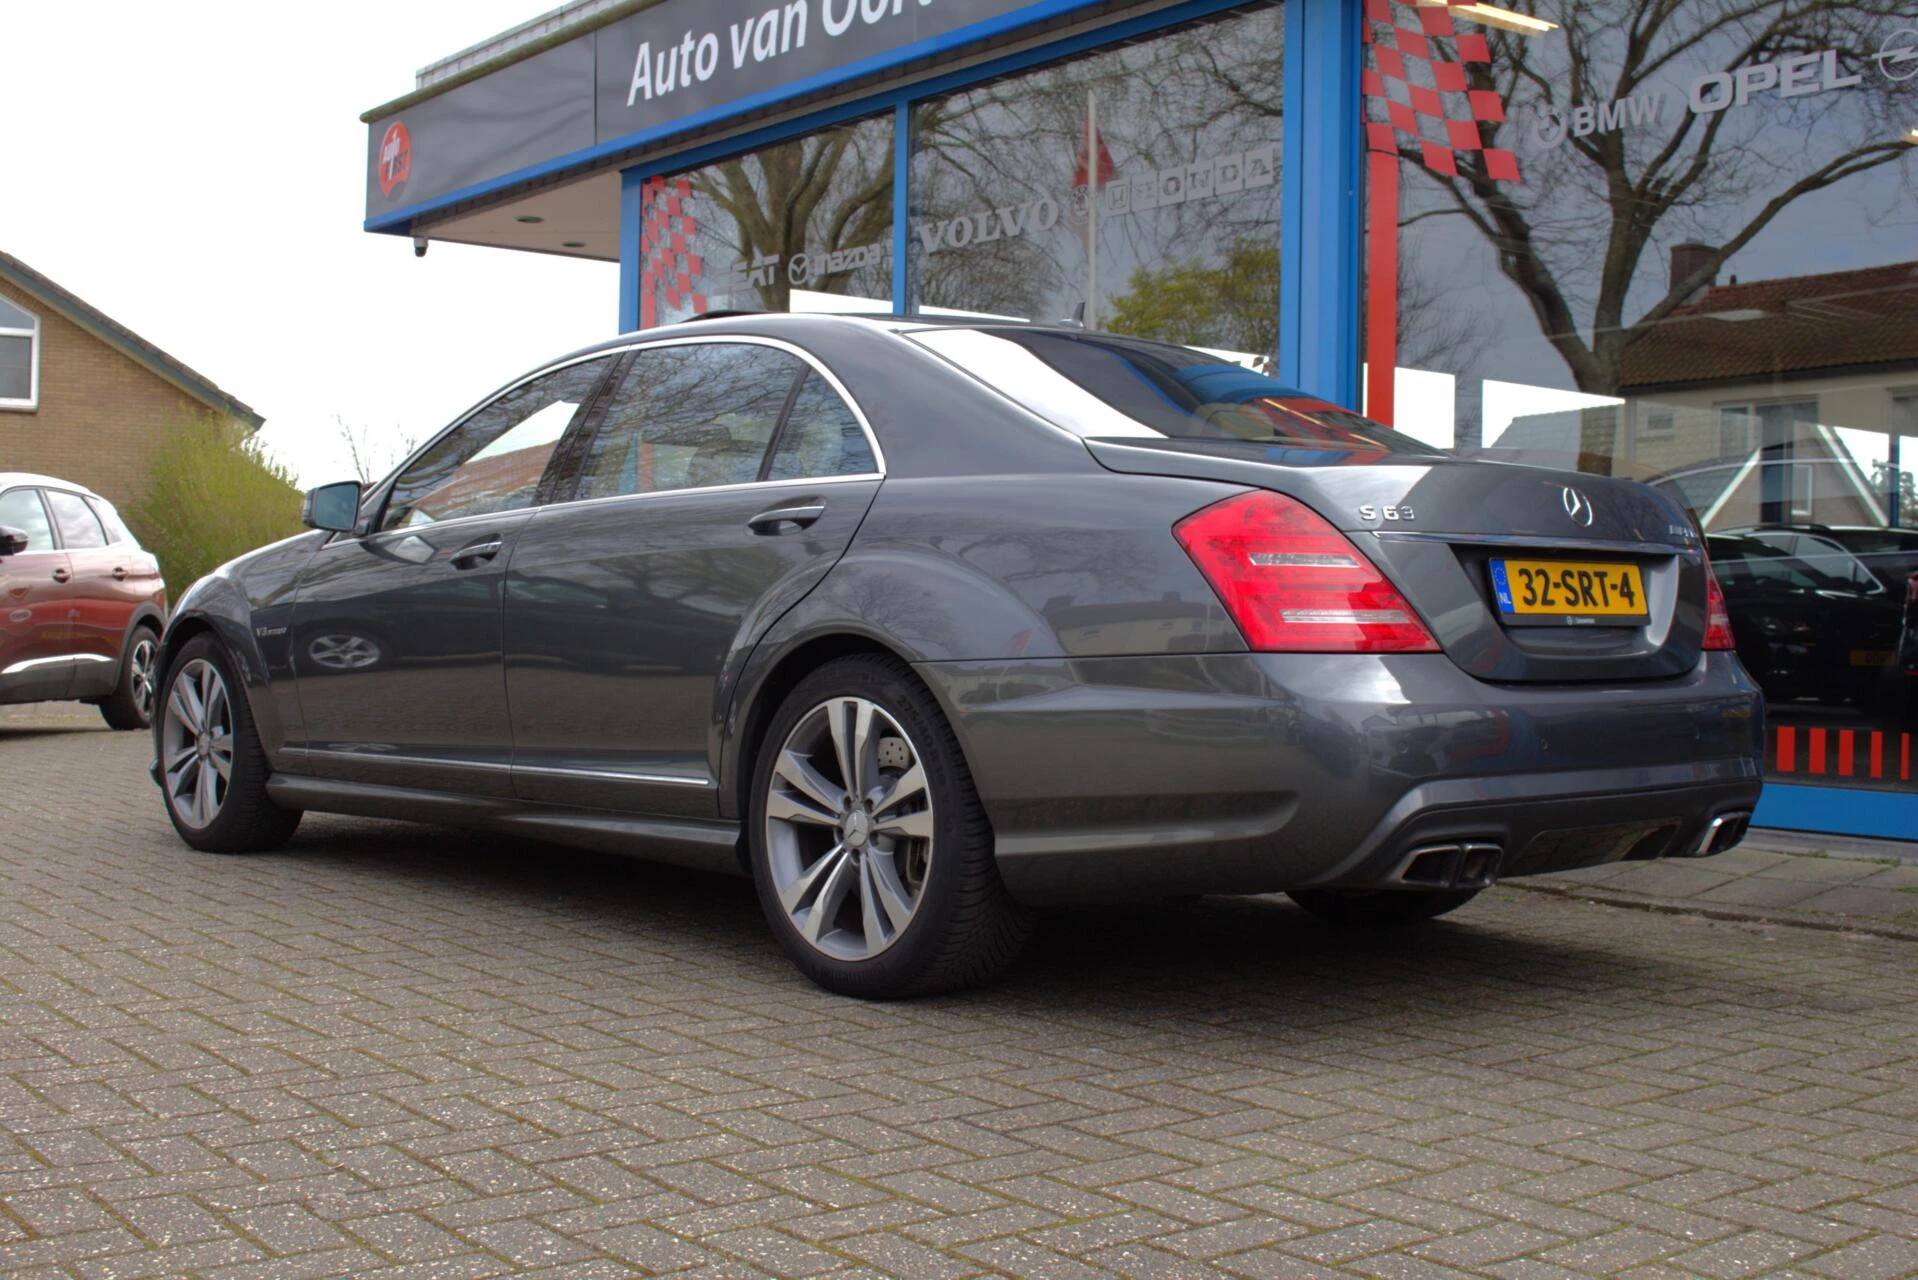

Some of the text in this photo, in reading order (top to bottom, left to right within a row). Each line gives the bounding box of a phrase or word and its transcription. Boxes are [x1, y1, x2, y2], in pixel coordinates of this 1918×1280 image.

[627, 29, 720, 107] Auto
[730, 0, 808, 70] van
[1689, 49, 1862, 114] OPEL
[1573, 93, 1665, 137] BMW
[917, 198, 1059, 253] VOLVO
[1359, 504, 1415, 521] S 63
[1517, 567, 1636, 608] 32-SRT-4
